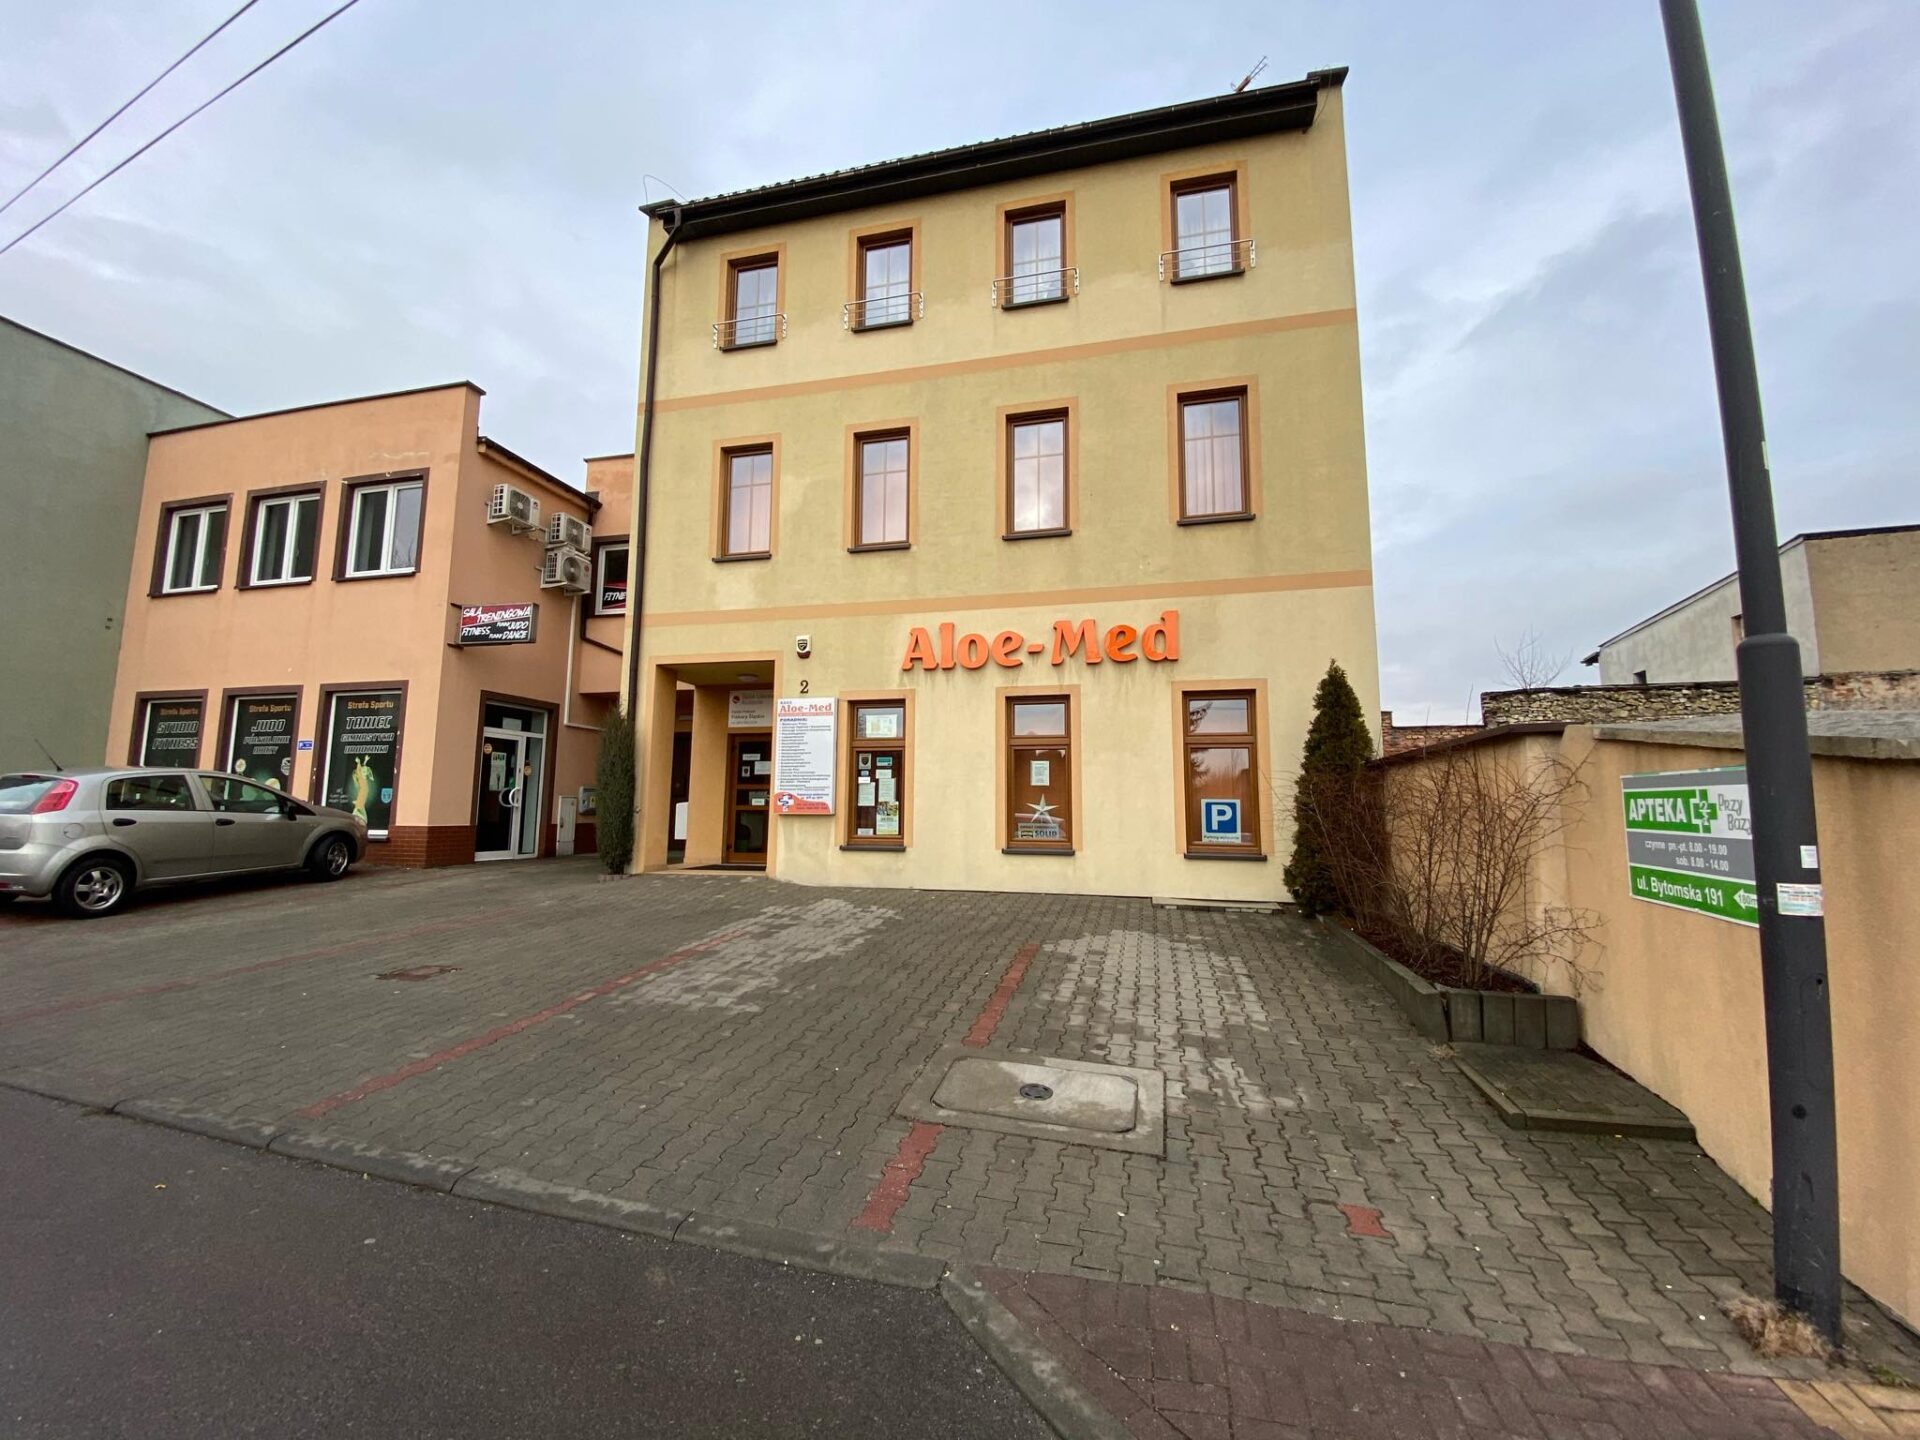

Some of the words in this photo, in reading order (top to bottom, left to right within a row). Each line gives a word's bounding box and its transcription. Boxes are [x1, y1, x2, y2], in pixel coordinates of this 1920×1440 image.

[463, 606, 483, 618] SALA
[476, 606, 531, 624] TRENINGOWA
[461, 626, 491, 637] FITNESS
[508, 621, 529, 630] JUDO
[502, 630, 528, 640] DANCE
[901, 609, 1180, 671] Aloe-Med
[800, 680, 809, 694] 2
[347, 701, 369, 709] Strefa
[370, 700, 394, 710] Sportu
[780, 703, 832, 713] Aloe-Med
[156, 721, 200, 734] STUDIO
[250, 718, 286, 733] JUDO
[345, 715, 393, 730] TANIEC
[1211, 804, 1233, 830] P
[1628, 797, 1687, 823] APTEKA
[1708, 843, 1728, 856] 19.00
[1675, 855, 1690, 867] sob.
[1710, 859, 1729, 872] 14.00
[1637, 875, 1649, 891] ul.
[1650, 877, 1702, 902] Bytomska
[1704, 887, 1724, 907] 191
